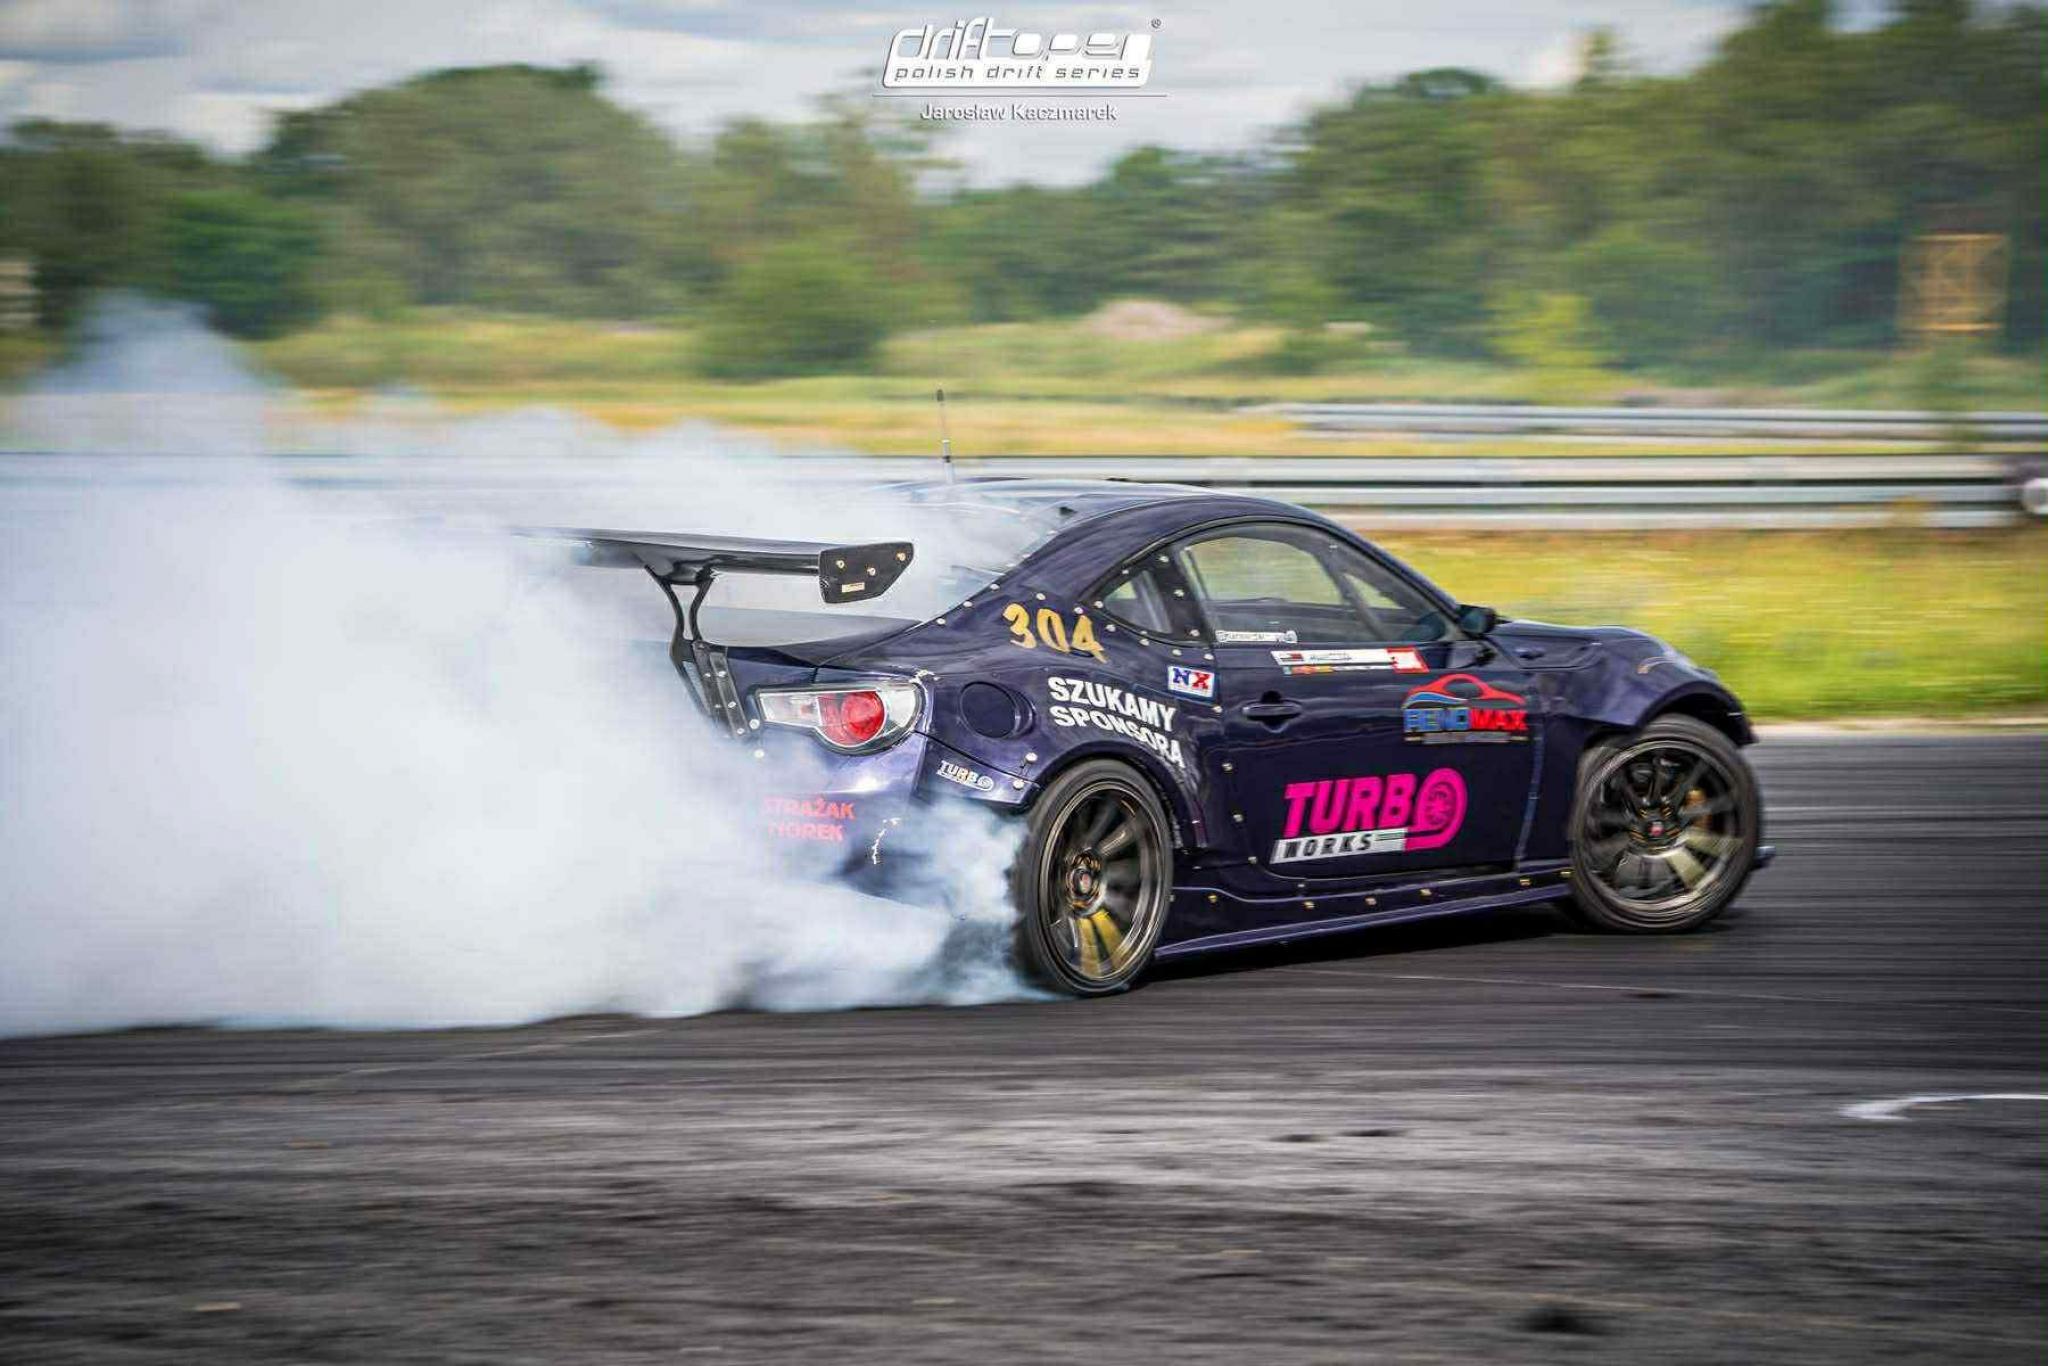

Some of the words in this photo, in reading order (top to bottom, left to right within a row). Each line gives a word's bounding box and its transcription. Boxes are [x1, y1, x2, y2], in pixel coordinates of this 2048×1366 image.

[1003, 603, 1107, 664] 304
[1048, 676, 1176, 732] SZUKAMY
[1172, 668, 1211, 690] NX
[1050, 705, 1186, 769] SPONSORA
[937, 760, 994, 790] TURBO
[1284, 768, 1468, 852] TURBO
[1284, 832, 1374, 859] WORKS
